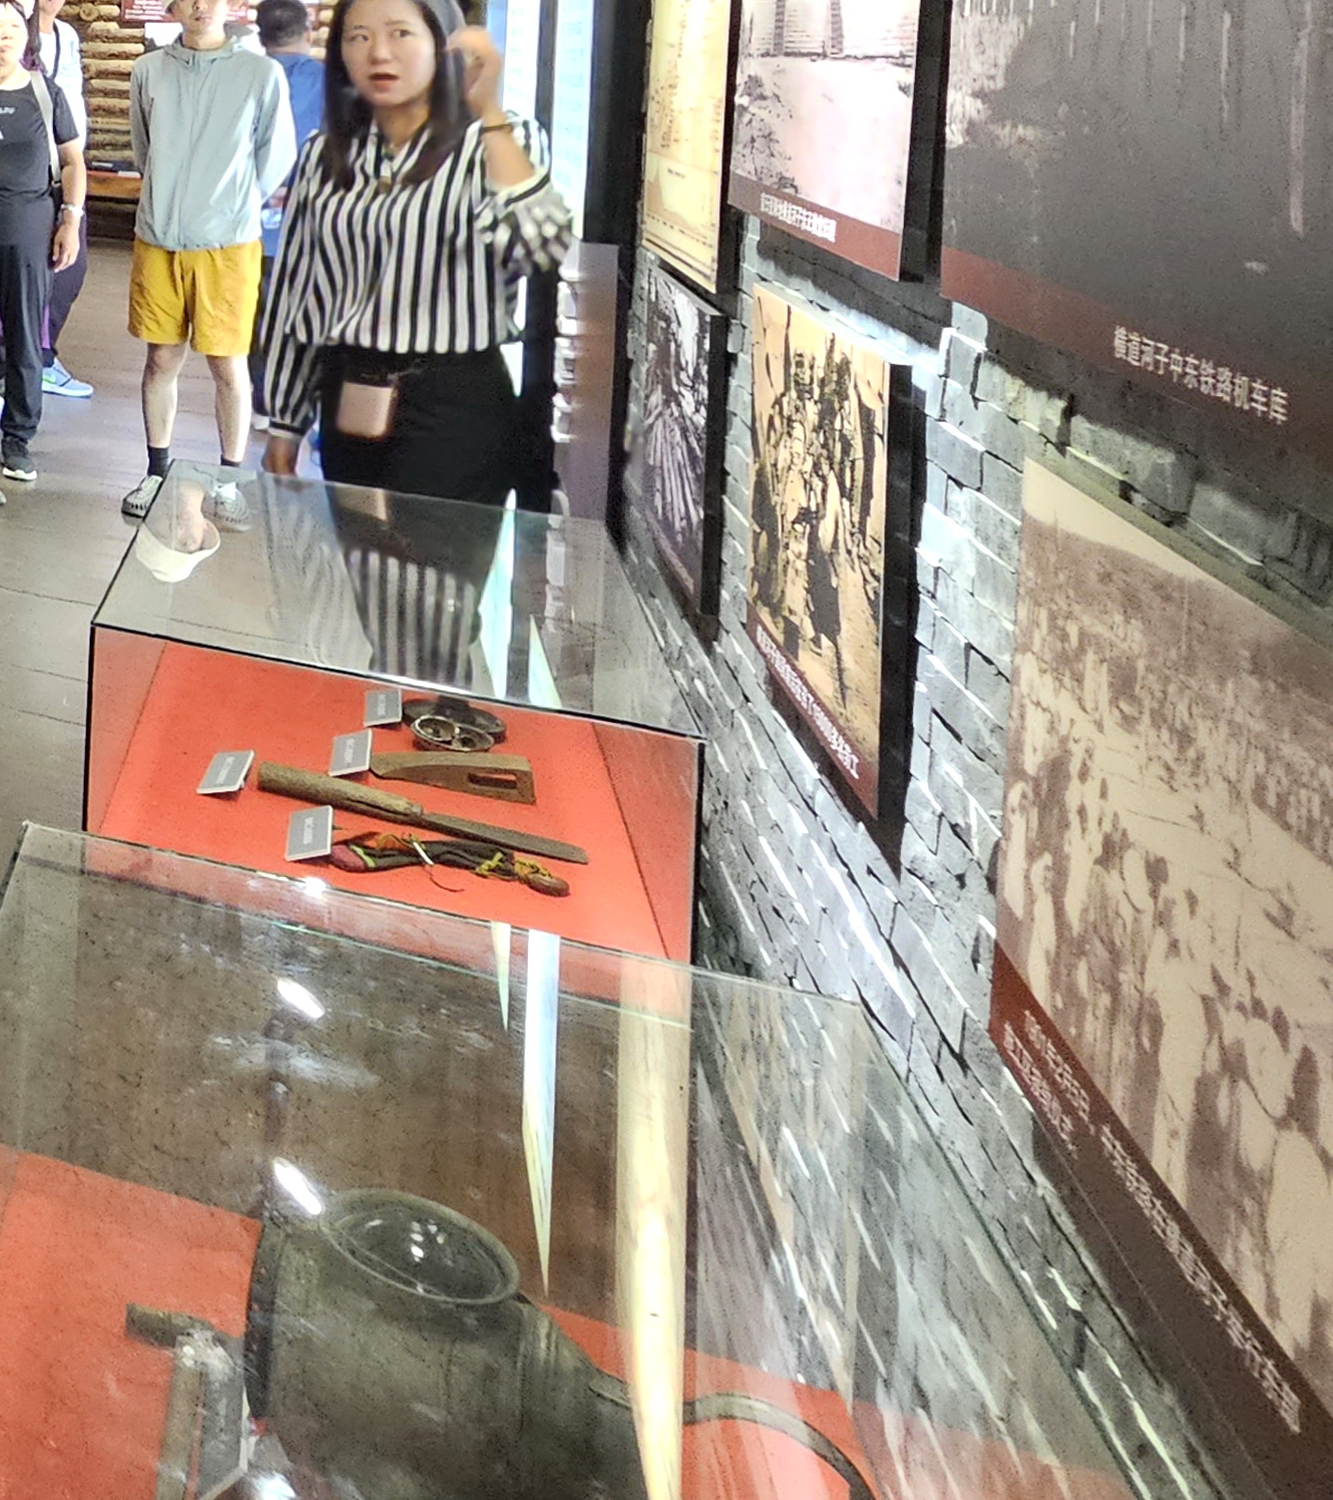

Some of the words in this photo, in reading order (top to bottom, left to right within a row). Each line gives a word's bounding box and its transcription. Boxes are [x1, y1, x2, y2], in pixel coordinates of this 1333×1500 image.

[1113, 325, 1289, 425] 横道河子中东铁路机车库
